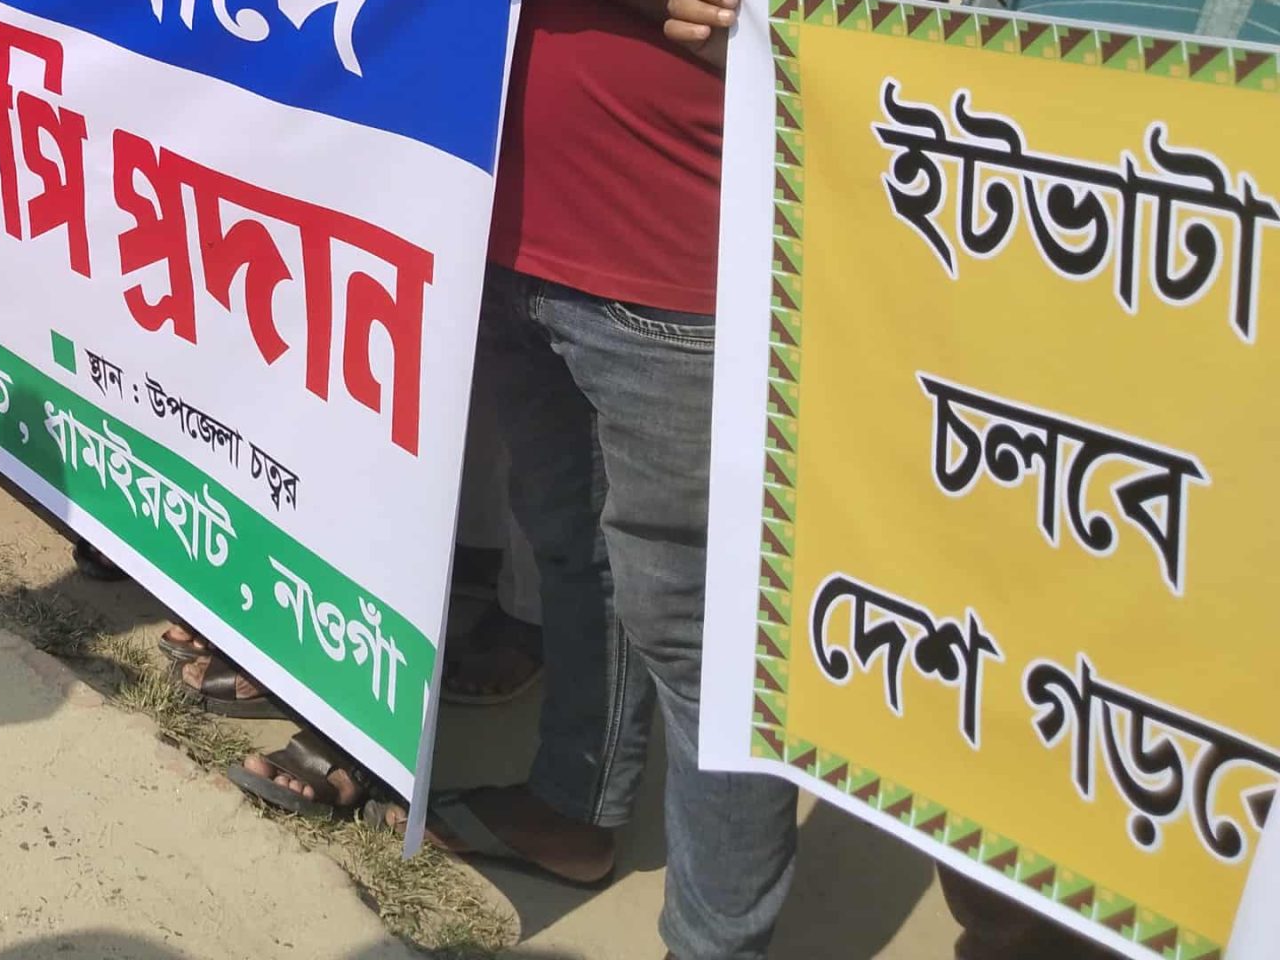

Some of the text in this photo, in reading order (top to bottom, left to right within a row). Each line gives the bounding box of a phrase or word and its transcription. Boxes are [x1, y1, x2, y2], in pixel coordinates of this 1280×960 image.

[113, 128, 434, 457] প্রদান
[872, 79, 1280, 342] ইটভাটা
[84, 348, 124, 398] স্থান
[145, 372, 243, 469] উপজেলা
[248, 440, 301, 511] চত্বর
[917, 373, 1209, 594] চলবে
[44, 400, 238, 567] ধামইরহাট
[268, 555, 408, 715] নওগাঁ
[810, 573, 1003, 748] দেশ
